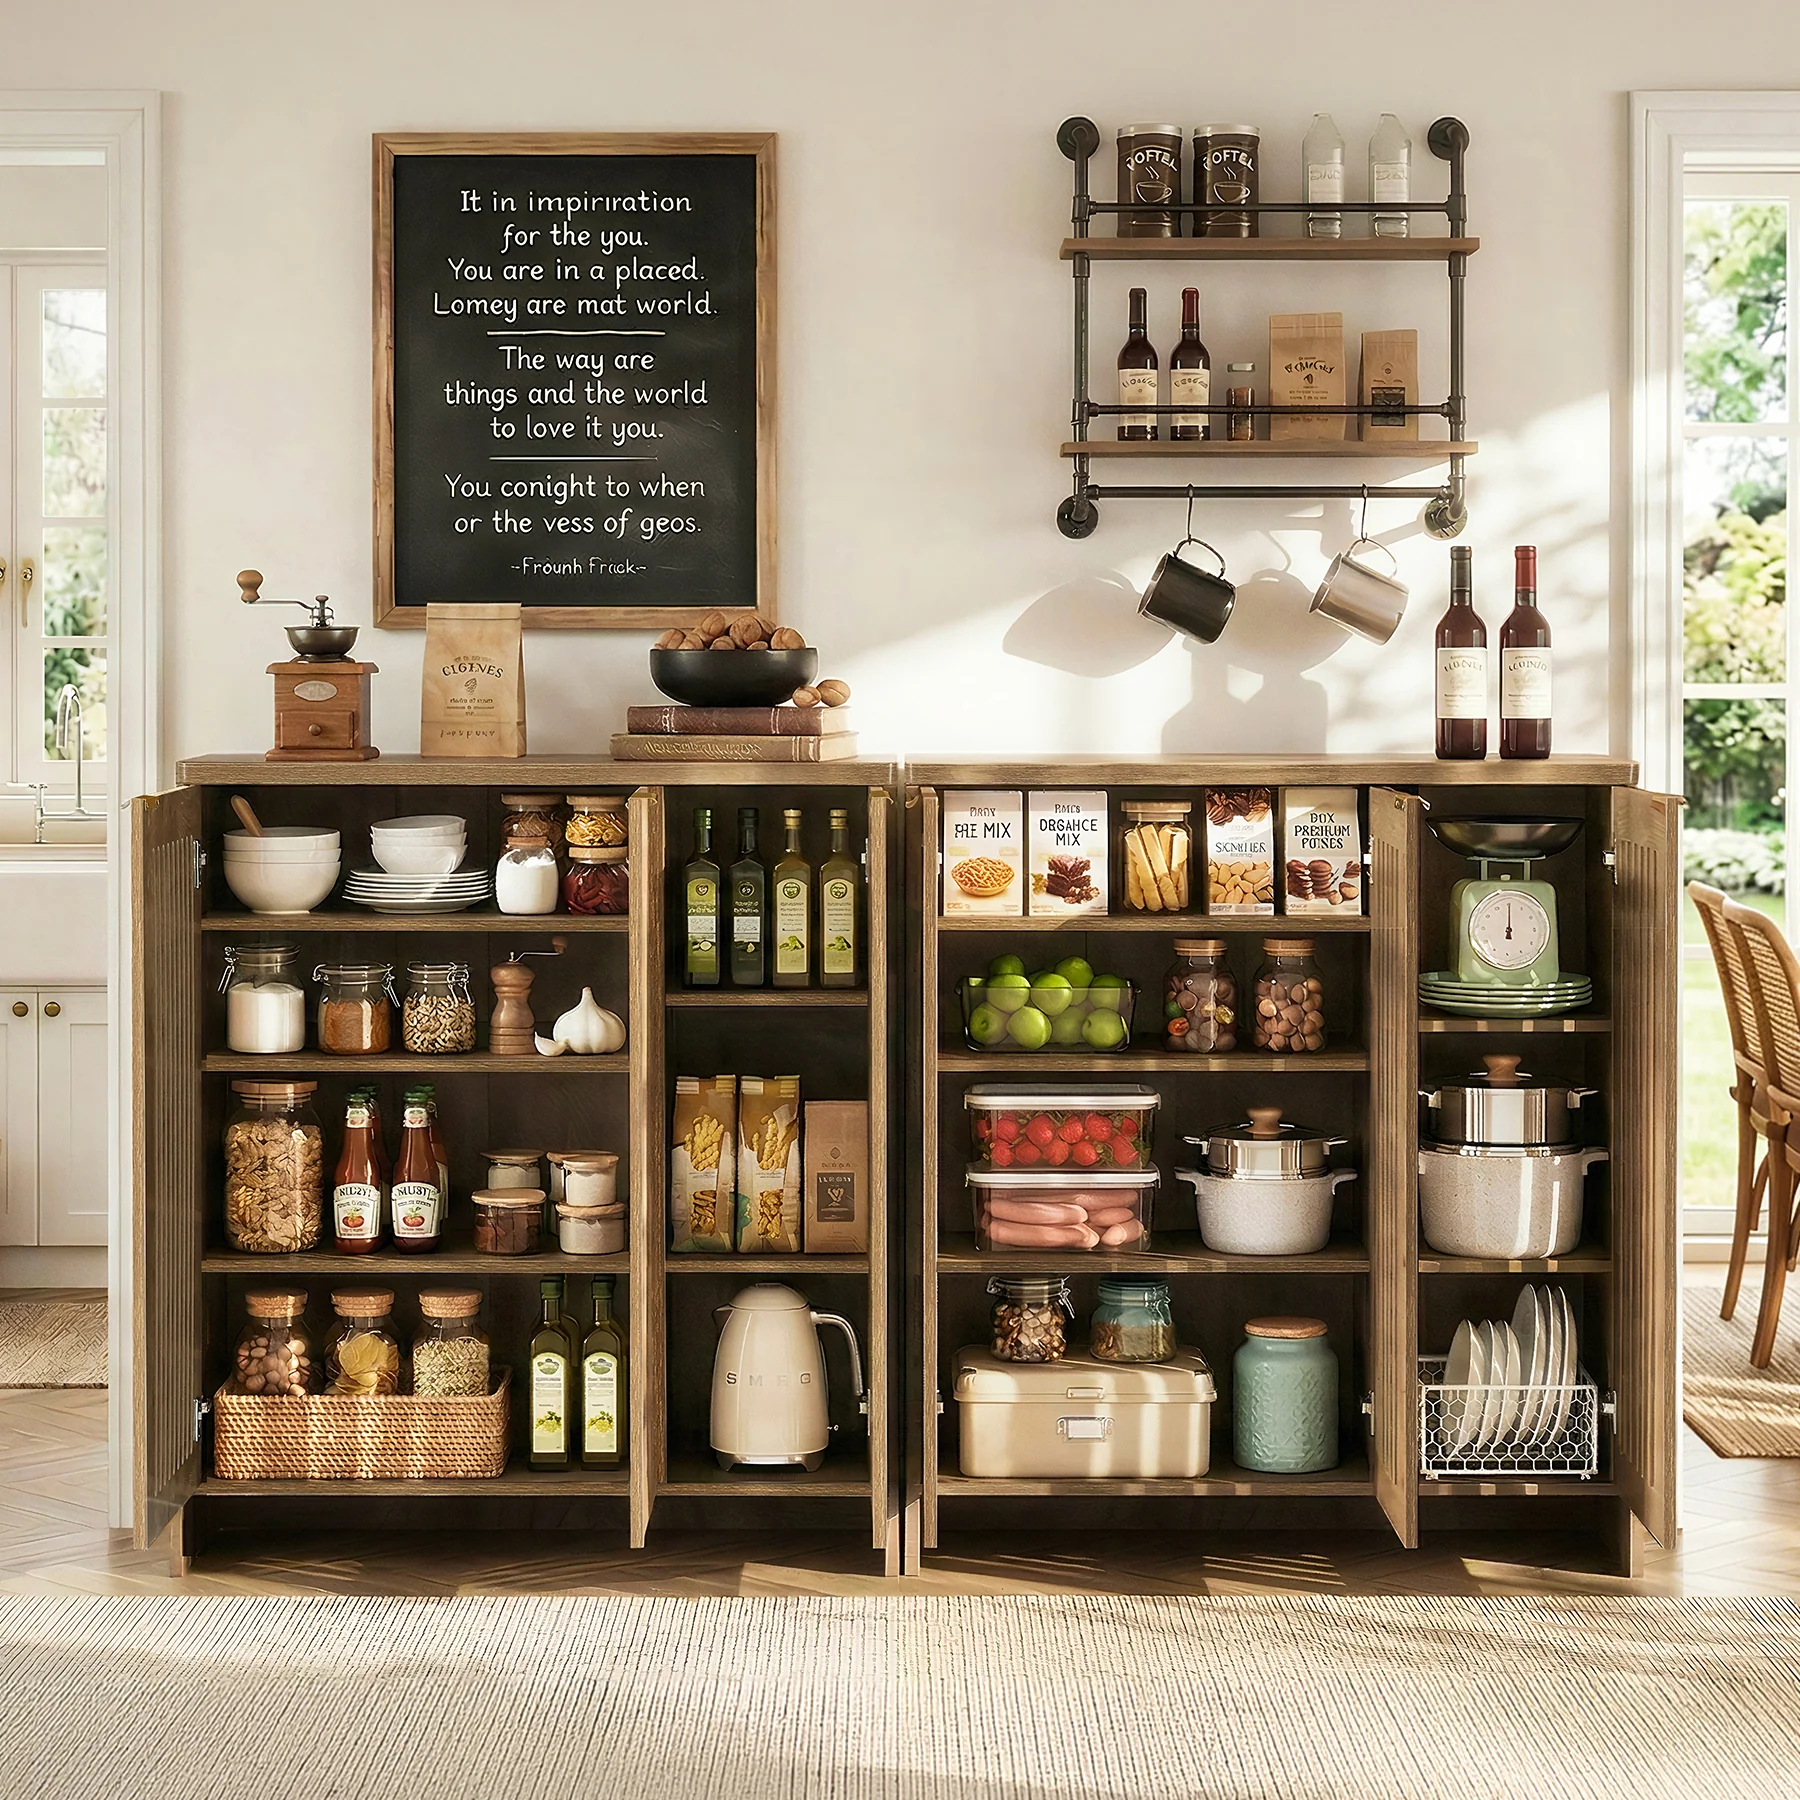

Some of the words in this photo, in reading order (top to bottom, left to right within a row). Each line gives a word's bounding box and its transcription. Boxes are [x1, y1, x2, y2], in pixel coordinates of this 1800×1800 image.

[460, 190, 482, 212] It
[492, 190, 517, 212] in
[500, 223, 541, 253] for
[549, 220, 591, 247] the
[600, 230, 650, 255] you.
[447, 257, 493, 281] You
[503, 264, 544, 281] are
[556, 258, 580, 281] in
[589, 265, 606, 281] a
[616, 256, 706, 290] placed.
[434, 292, 517, 323] Lomey
[526, 299, 567, 315] are
[578, 294, 627, 315] mat
[636, 290, 719, 315] world.
[498, 345, 546, 370] The
[555, 354, 604, 378] way
[614, 354, 655, 370] are
[443, 380, 518, 412] things
[528, 379, 576, 405] and
[583, 379, 625, 405] the
[634, 379, 709, 404] world
[489, 416, 516, 439] to
[526, 413, 576, 440] love
[586, 414, 603, 439] it
[612, 422, 664, 447] you.
[444, 473, 492, 498] You
[500, 473, 597, 505] conight
[605, 475, 630, 497] to
[638, 472, 706, 498] when
[454, 514, 483, 533] or
[491, 508, 533, 534] the
[542, 516, 595, 534] vess
[603, 507, 634, 539] of
[639, 516, 702, 542] geos.
[983, 822, 1012, 839] MIX
[1056, 832, 1081, 846] MIX
